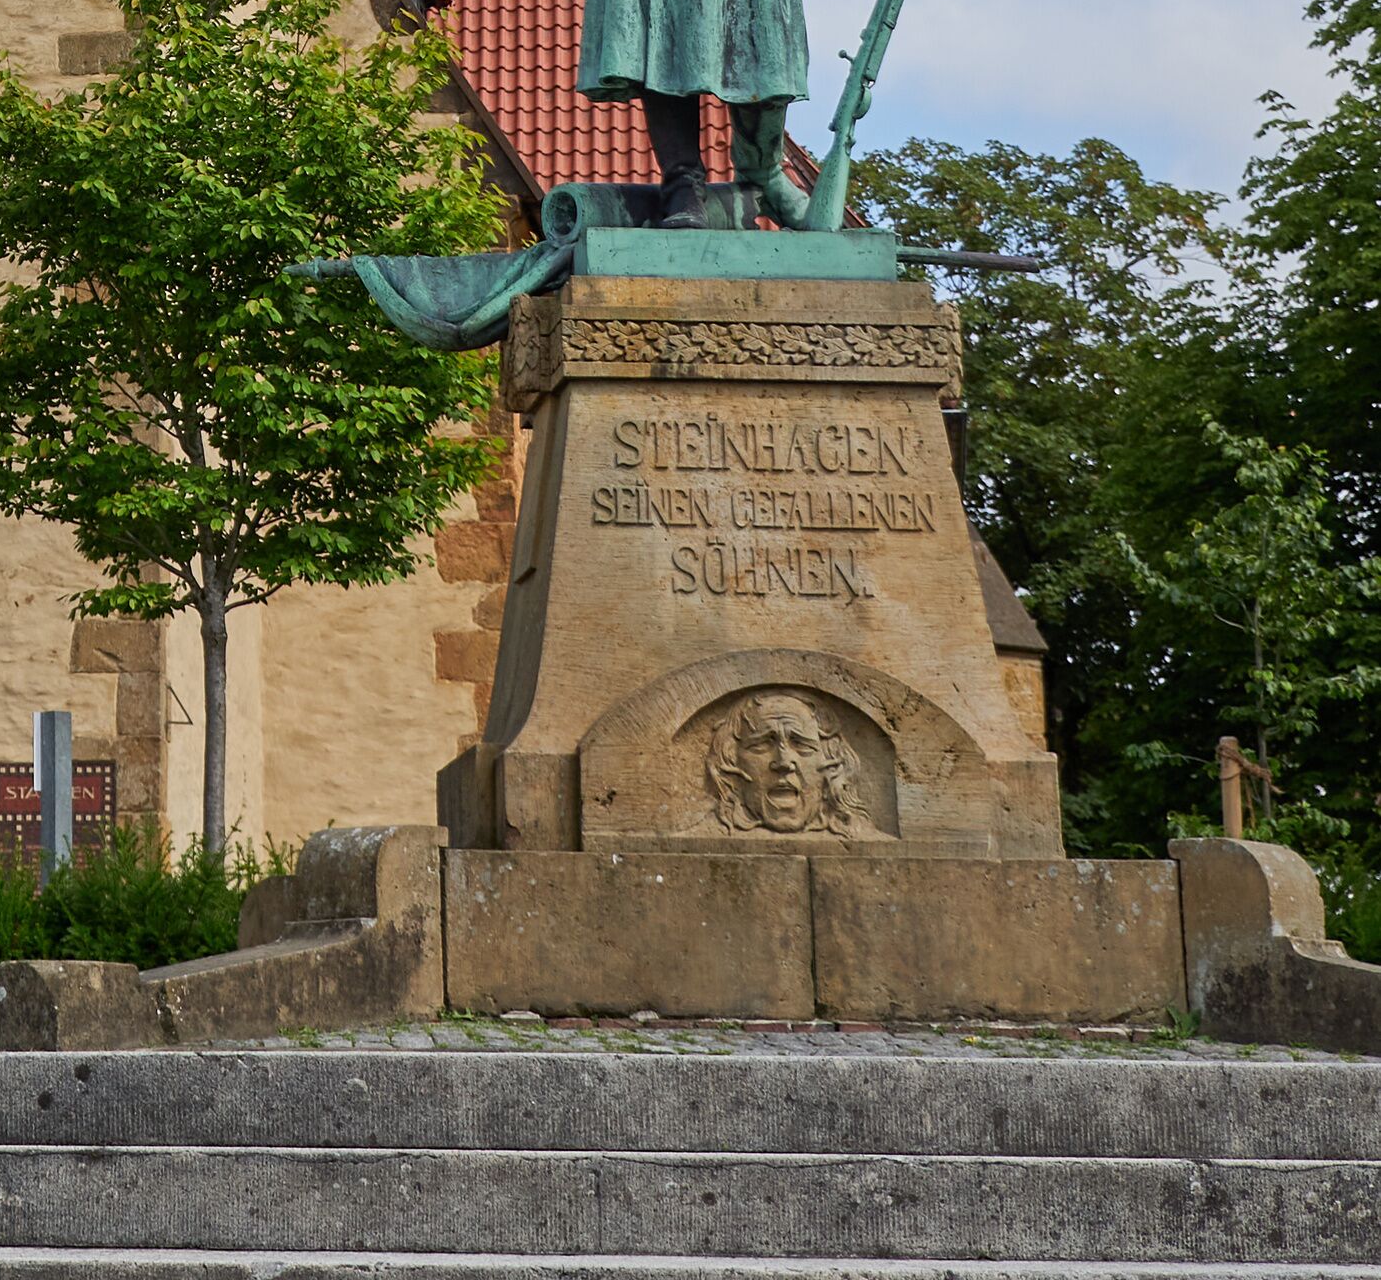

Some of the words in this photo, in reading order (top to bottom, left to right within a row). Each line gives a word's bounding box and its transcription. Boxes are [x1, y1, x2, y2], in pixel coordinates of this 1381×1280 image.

[613, 413, 909, 476] STEINHAGEN
[592, 480, 714, 528] SEINEN
[730, 490, 936, 532] GEFALLENEN
[4, 785, 95, 800] STAEN
